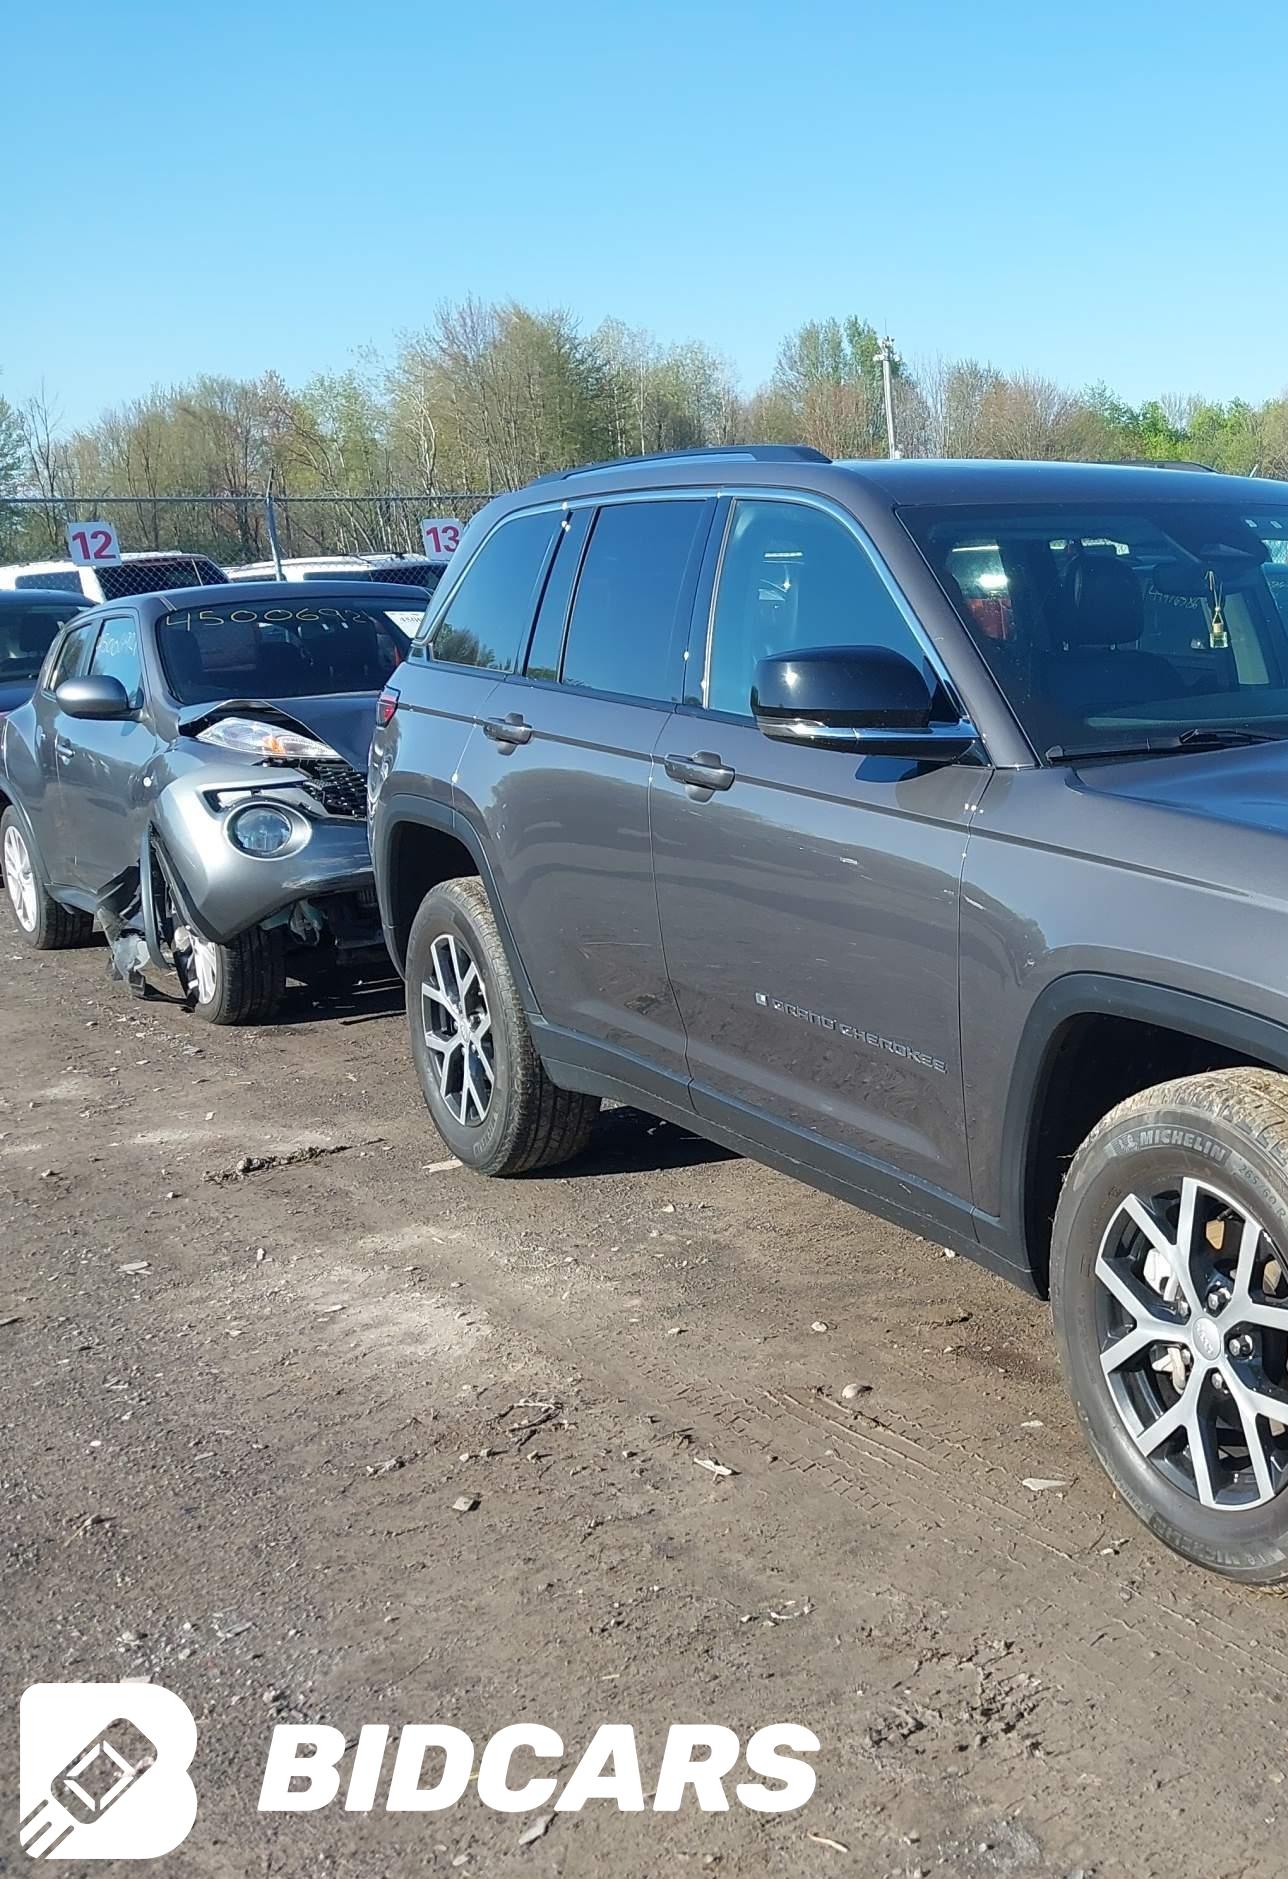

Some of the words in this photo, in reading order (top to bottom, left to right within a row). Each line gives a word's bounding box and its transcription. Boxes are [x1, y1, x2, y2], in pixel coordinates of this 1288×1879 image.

[72, 530, 116, 560] 12
[426, 526, 460, 553] 13
[772, 999, 837, 1030] GRAND
[839, 1023, 948, 1073] CHEROKEE
[1140, 1129, 1226, 1161] MICHELIN
